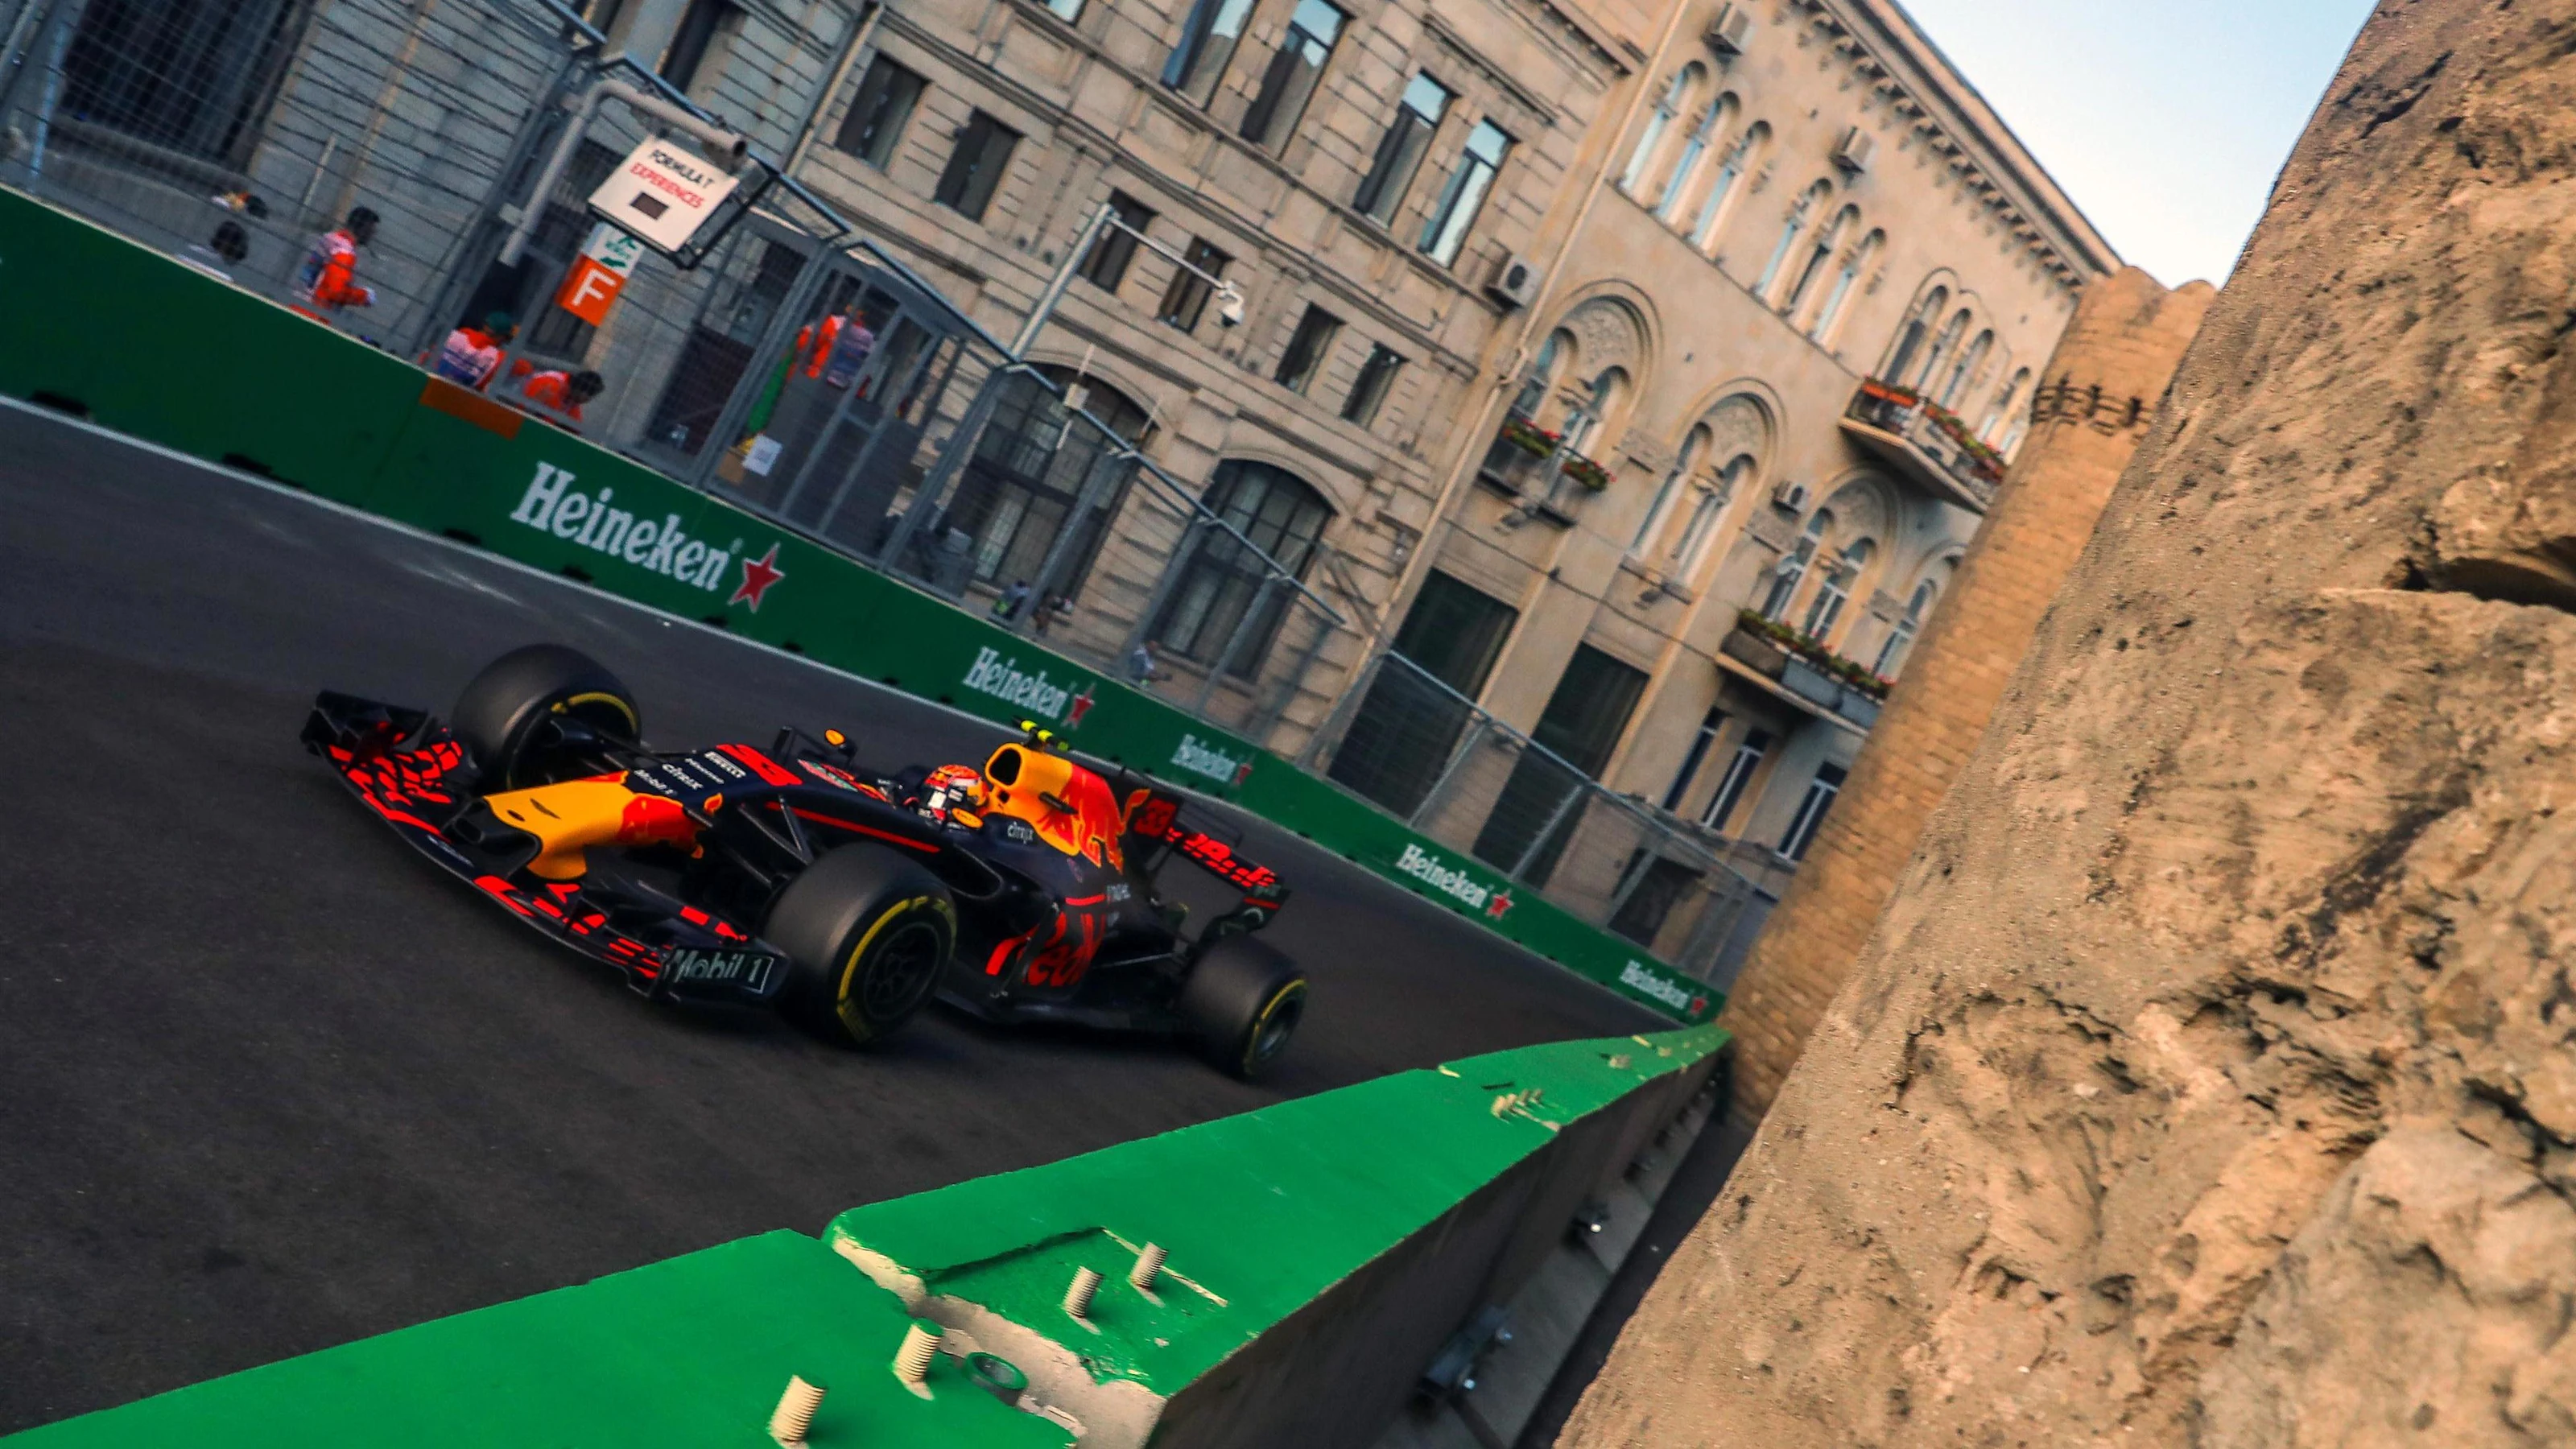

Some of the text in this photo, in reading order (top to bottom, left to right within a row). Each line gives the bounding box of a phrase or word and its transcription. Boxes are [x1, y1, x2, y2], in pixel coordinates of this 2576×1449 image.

[630, 162, 705, 208] EXPERIENCES
[650, 149, 703, 184] FORMULA
[571, 267, 617, 307] F
[510, 460, 730, 592] Heineken
[963, 645, 1069, 720] Heineken
[1395, 842, 1488, 909] Heineken
